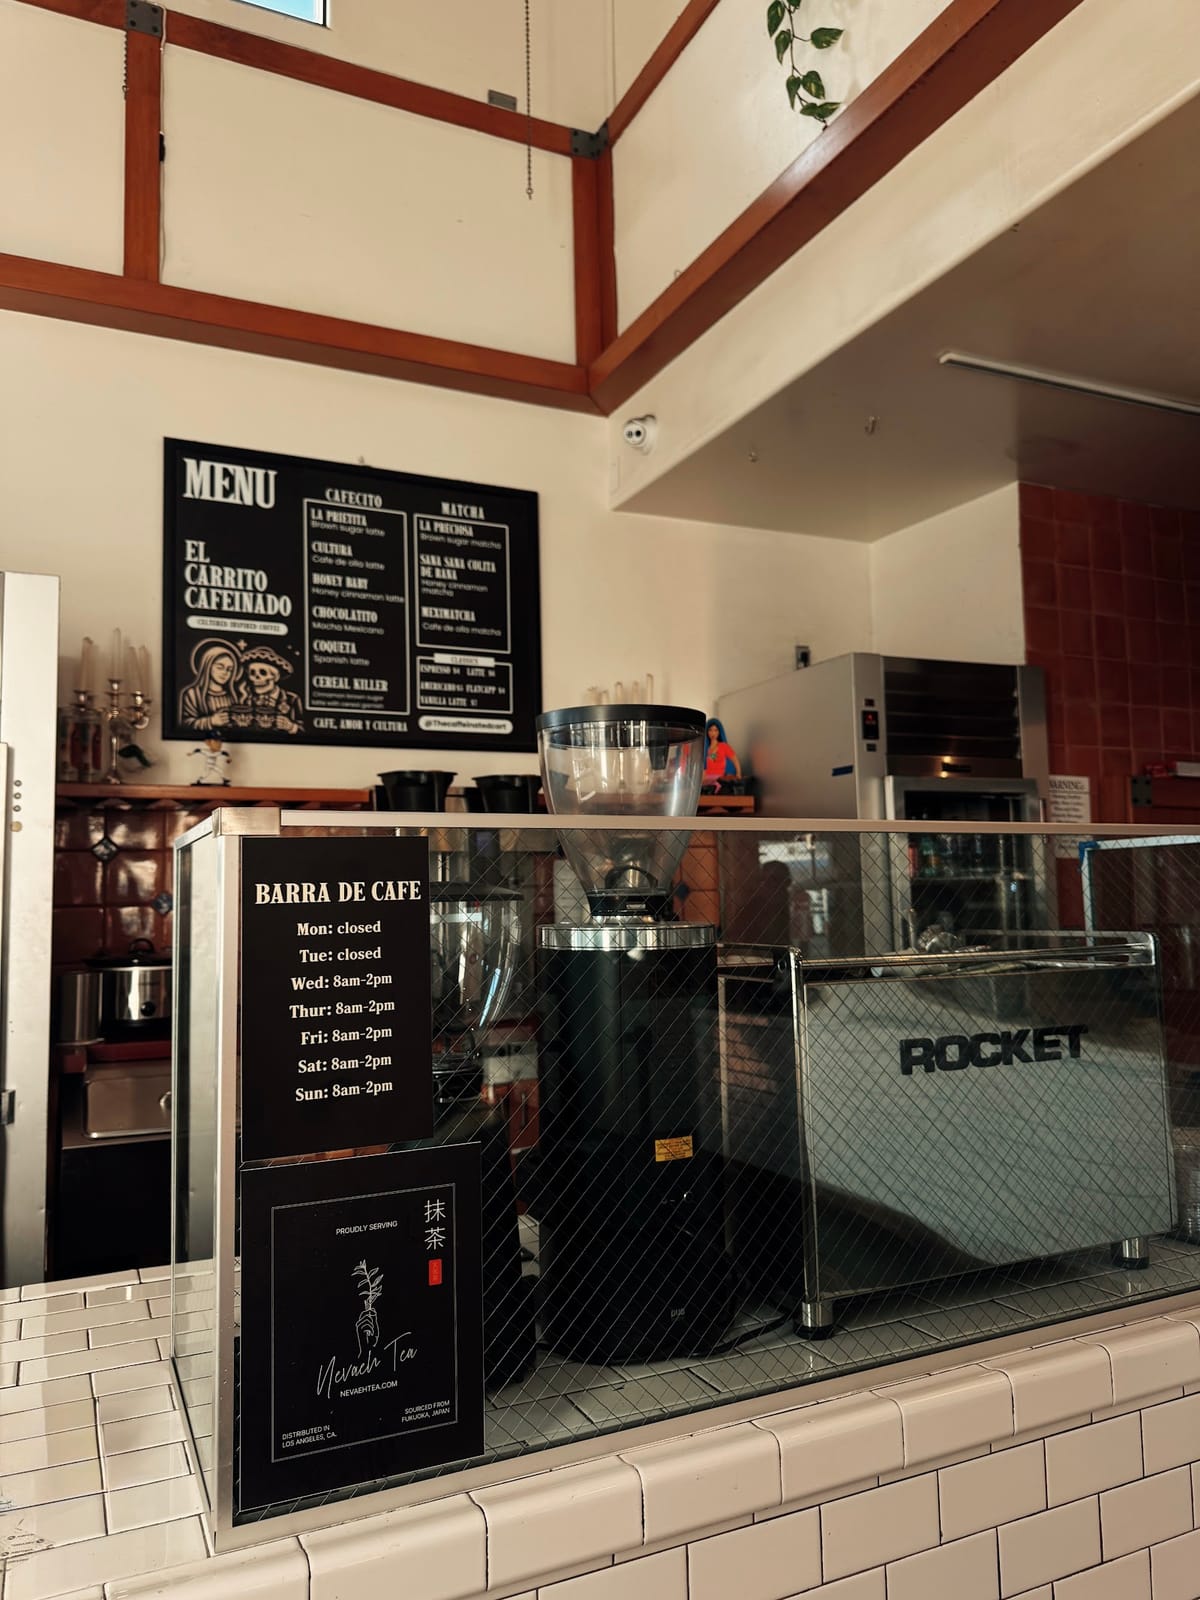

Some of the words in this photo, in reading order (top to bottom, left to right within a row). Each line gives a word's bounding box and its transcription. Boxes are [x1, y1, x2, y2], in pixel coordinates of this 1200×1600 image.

[183, 458, 278, 509] MENU
[325, 488, 382, 508] CAFECITO
[310, 508, 323, 520] LA
[441, 501, 485, 520] MATCHA
[311, 521, 338, 530] Brown
[340, 524, 364, 535] sugar
[366, 527, 385, 537] latte
[420, 520, 432, 532] LA
[434, 521, 474, 537] PRECIOSA
[420, 533, 444, 542] Brown
[446, 536, 468, 547] sugar
[185, 539, 210, 563] EL
[312, 541, 352, 557] CULTURA
[335, 558, 347, 566] de
[366, 561, 384, 570] latte
[420, 554, 442, 567] SANA
[444, 556, 465, 570] SANA
[184, 563, 268, 592] CARRITO
[312, 572, 343, 587] HONEY
[420, 566, 432, 578] DE
[184, 586, 292, 617] CAFEINADO
[340, 590, 384, 601] cinnamon
[386, 594, 405, 604] latte
[471, 628, 502, 636] matcha
[312, 640, 357, 654] COQUETA
[313, 655, 349, 665] Spanish
[350, 658, 370, 666] latte
[466, 667, 485, 677] LATTE
[312, 676, 350, 690] CEREAL
[352, 678, 388, 692] KILLER
[448, 698, 468, 706] LATTE
[340, 718, 363, 730] AMOR
[365, 720, 372, 730] Y
[372, 720, 408, 732] CULTURA
[255, 882, 331, 904] BARRA
[338, 882, 366, 902] DE
[371, 880, 422, 901] CAFE
[297, 922, 333, 936] Mon:
[337, 920, 382, 934] closed
[299, 949, 333, 962] Tue:
[337, 946, 382, 960] closed
[291, 976, 330, 990] Wed:
[333, 973, 392, 988] 8am-2pm
[289, 1004, 332, 1018] Thur:
[336, 1000, 395, 1014] 8am-2pm
[301, 1030, 328, 1045] Fri:
[332, 1027, 392, 1042] 8am-2pm
[900, 1024, 1088, 1075] ROCKET
[298, 1060, 328, 1073] Sat:
[331, 1054, 392, 1070] 8am-2pm
[296, 1088, 328, 1101] Sun:
[332, 1080, 393, 1096] 8am-2pm
[336, 1224, 368, 1235] PROUDLY
[369, 1220, 398, 1230] SERVING
[424, 1199, 446, 1250] 抹茶
[384, 1332, 418, 1372] Tea
[340, 1380, 398, 1398] NEVAEHTEA.COM
[401, 1412, 430, 1422] FUKUOKA,
[432, 1408, 450, 1417] JAPAN
[404, 1404, 432, 1414] SOURCED
[433, 1400, 450, 1410] FROM
[282, 1427, 322, 1440] DISTRIBUTED
[323, 1424, 330, 1432] IN
[282, 1440, 294, 1448] LOS
[296, 1433, 326, 1445] ANGELES,
